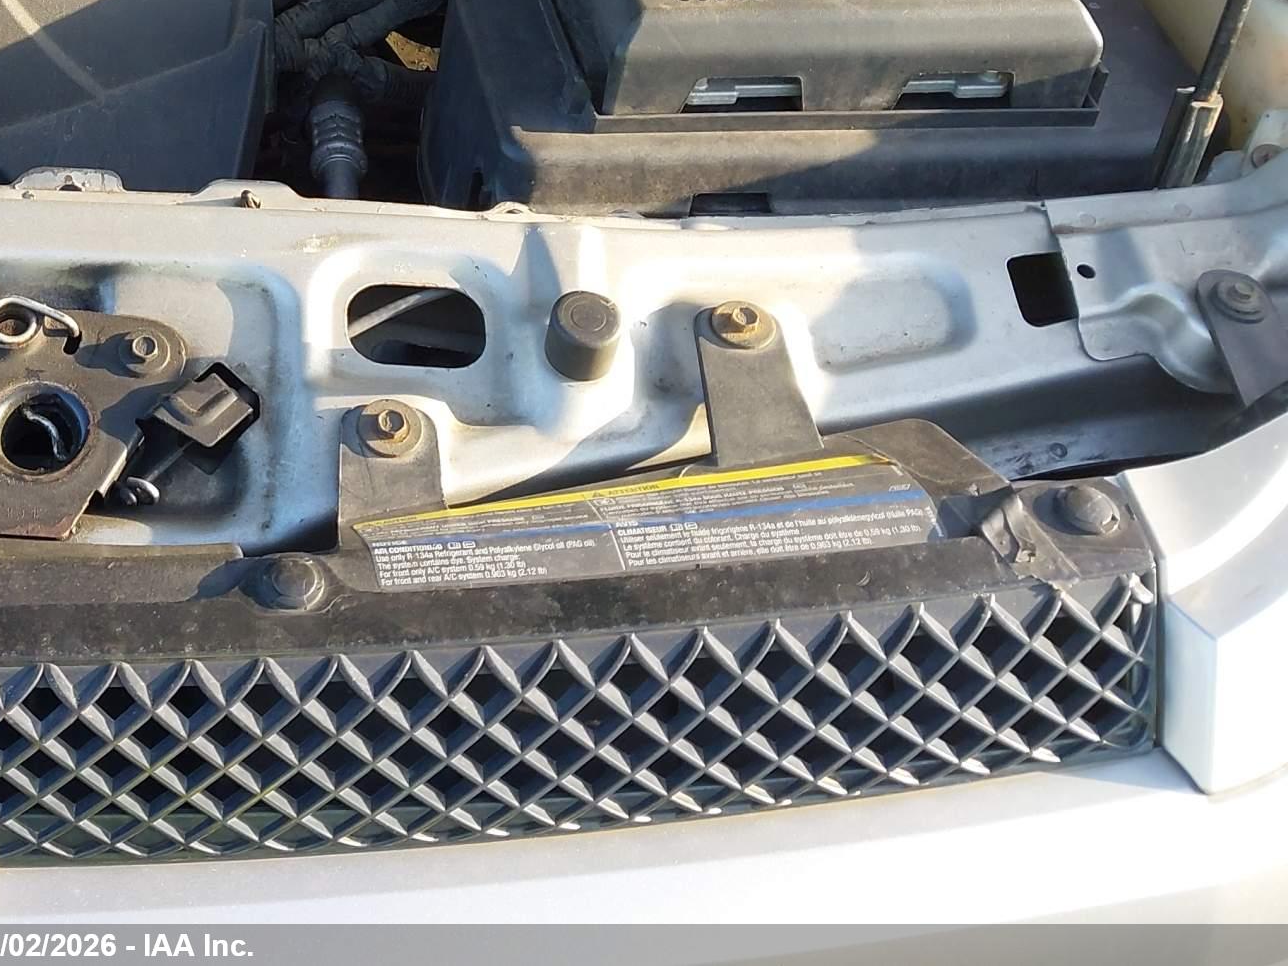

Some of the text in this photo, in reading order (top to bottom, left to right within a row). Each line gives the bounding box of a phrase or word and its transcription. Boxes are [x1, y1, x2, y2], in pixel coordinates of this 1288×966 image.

[617, 525, 666, 536] CLIMATISEUR
[376, 554, 389, 562] Use
[391, 553, 405, 562] only
[434, 548, 473, 559] Refrigerant
[476, 547, 488, 555] and
[533, 542, 554, 552] Glycol
[378, 562, 390, 570] The
[392, 561, 418, 570] system
[466, 555, 493, 564] System
[380, 570, 390, 578] For
[392, 569, 409, 577] front
[411, 568, 426, 576] only
[427, 566, 440, 574] A/C
[441, 565, 466, 574] system
[381, 578, 392, 586] For
[394, 577, 412, 585] front
[412, 576, 426, 584] and
[444, 573, 457, 581] A/C
[458, 572, 484, 581] system
[518, 567, 536, 577] (2.12
